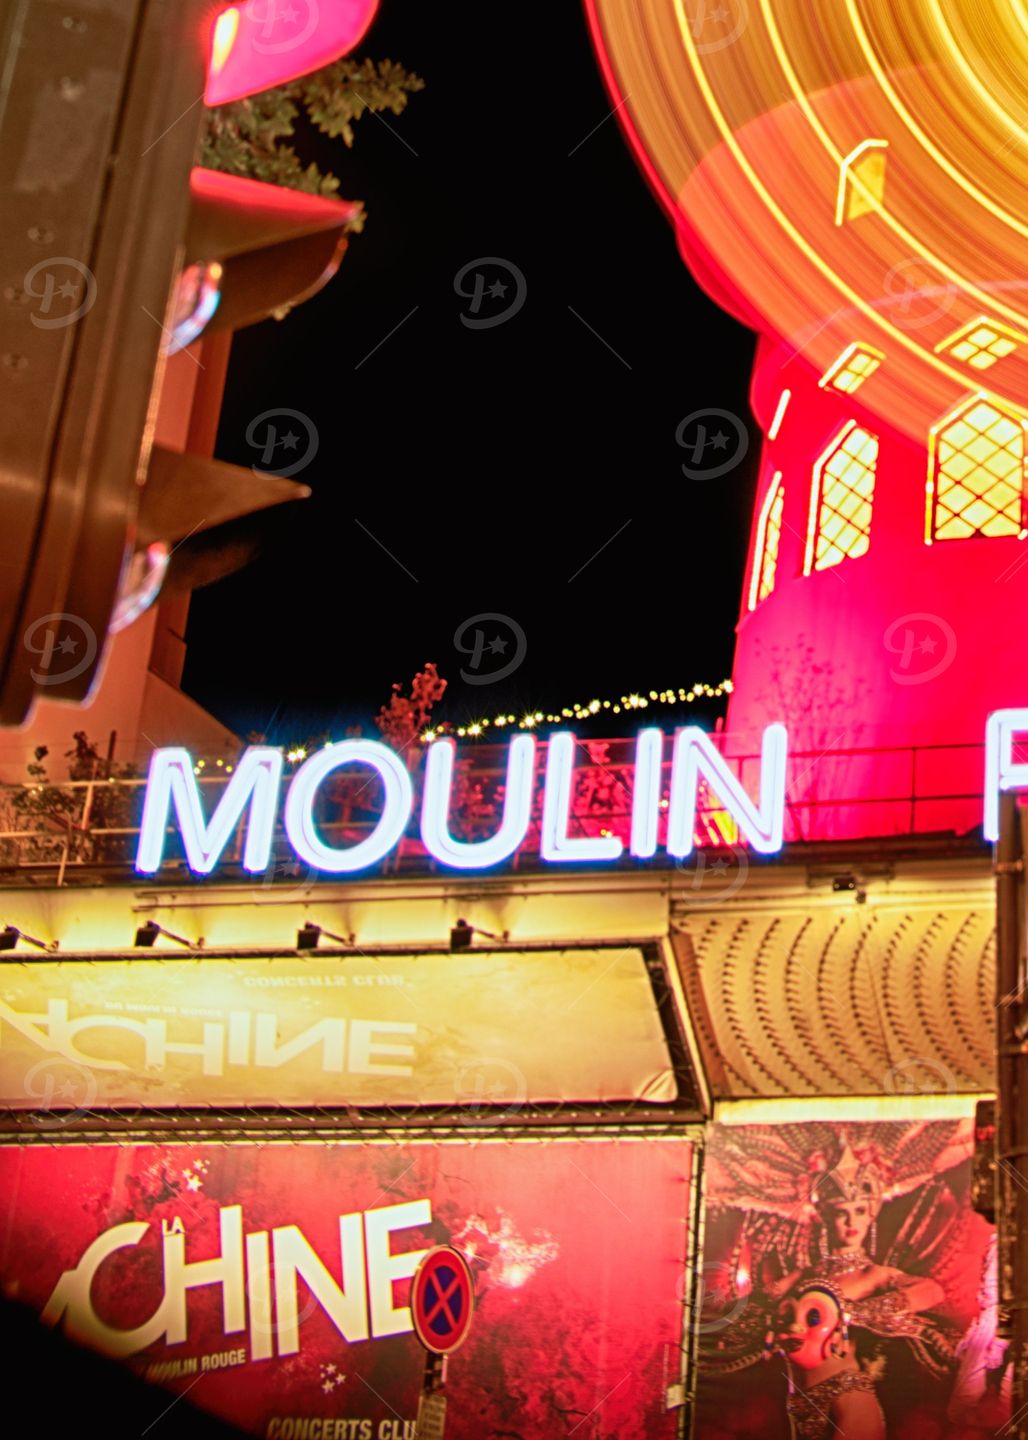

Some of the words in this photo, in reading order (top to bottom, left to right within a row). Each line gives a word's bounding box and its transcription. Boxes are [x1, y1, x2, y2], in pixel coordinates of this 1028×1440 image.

[135, 723, 788, 874] MOULIN
[162, 1216, 186, 1236] LA
[201, 1349, 246, 1372] ROUGE
[266, 1416, 372, 1440] CONCERTS
[378, 1417, 417, 1440] CLU
